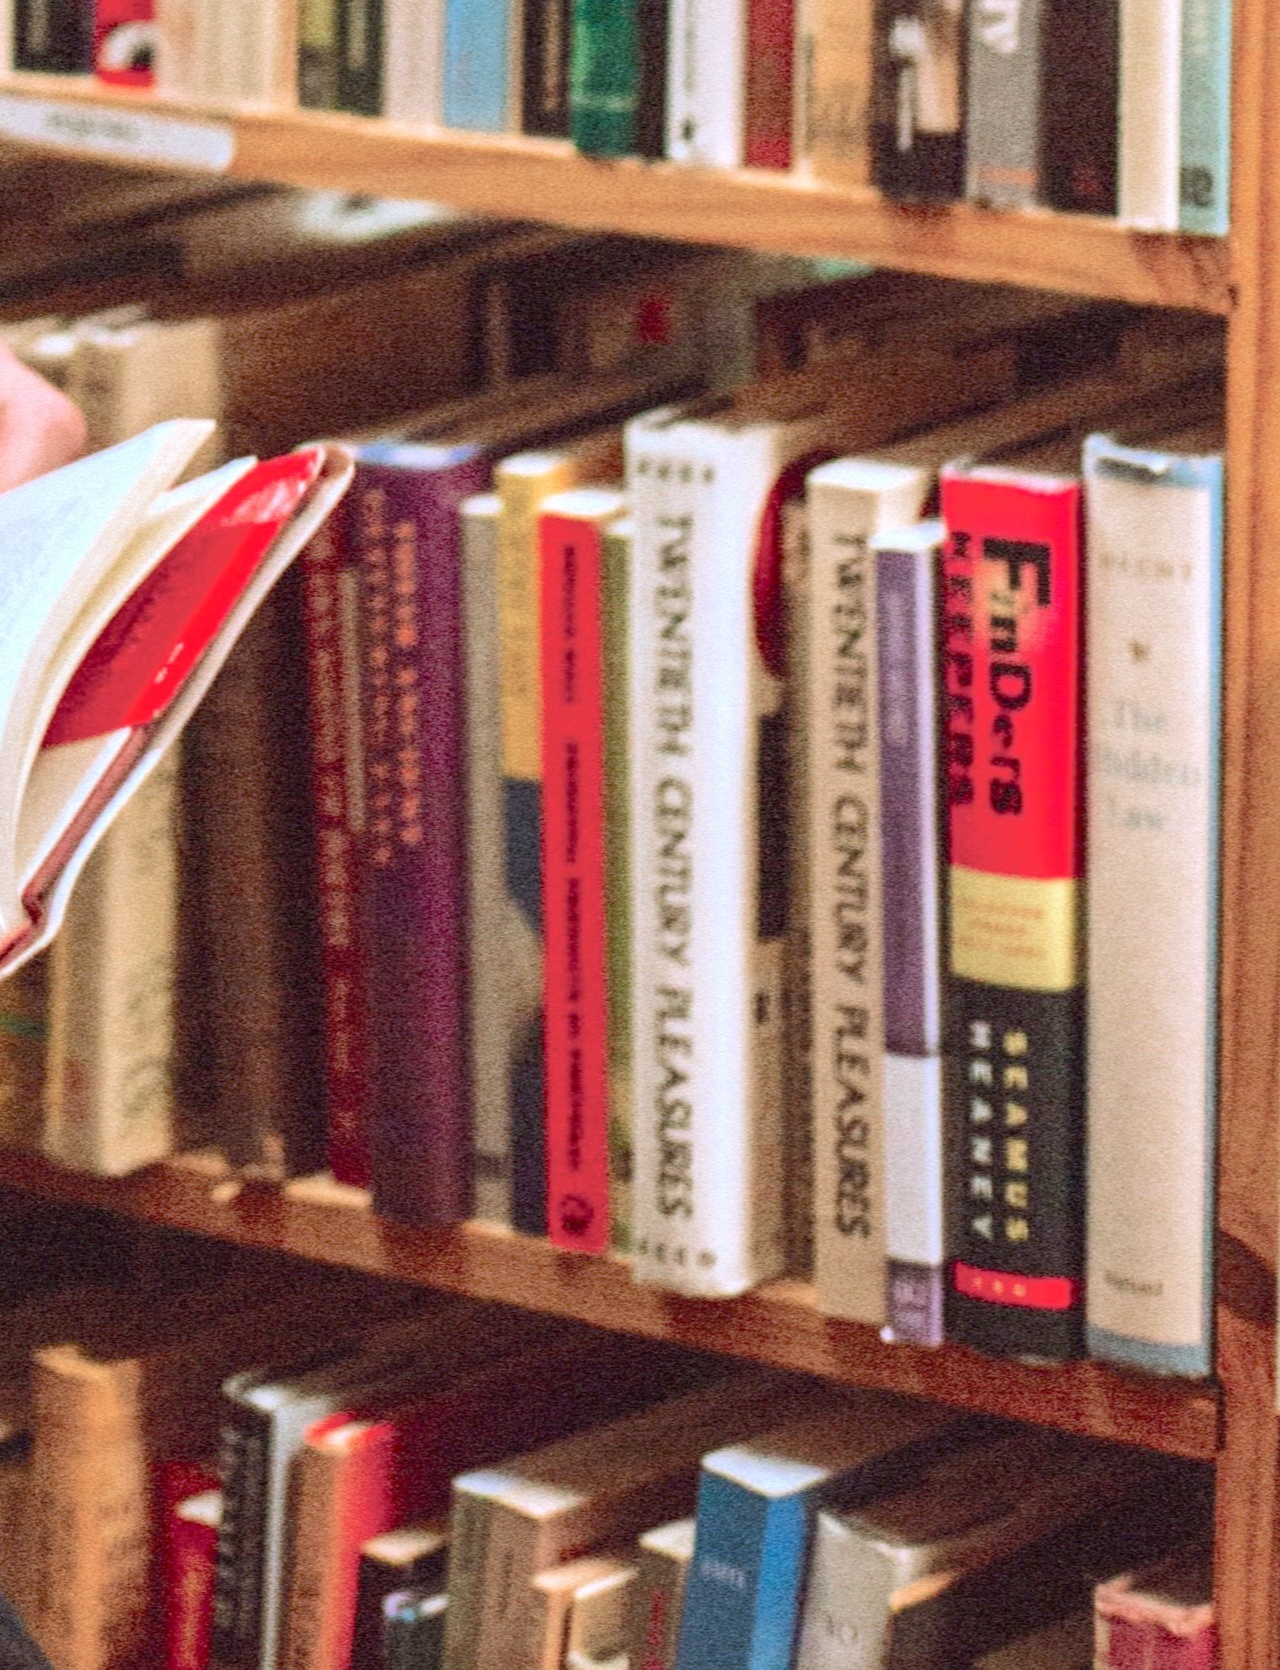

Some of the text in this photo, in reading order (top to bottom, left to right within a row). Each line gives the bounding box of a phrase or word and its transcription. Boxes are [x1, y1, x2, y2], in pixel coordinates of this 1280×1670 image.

[947, 530, 975, 807] KEEPERS
[654, 513, 694, 1224] TWENTIETH CENTURY PLEASURES
[833, 530, 870, 1243] TWENTIETH CENTURY PLEASURES
[968, 1019, 994, 1242] HEANEY
[1002, 1029, 1030, 1244] SEAMUS
